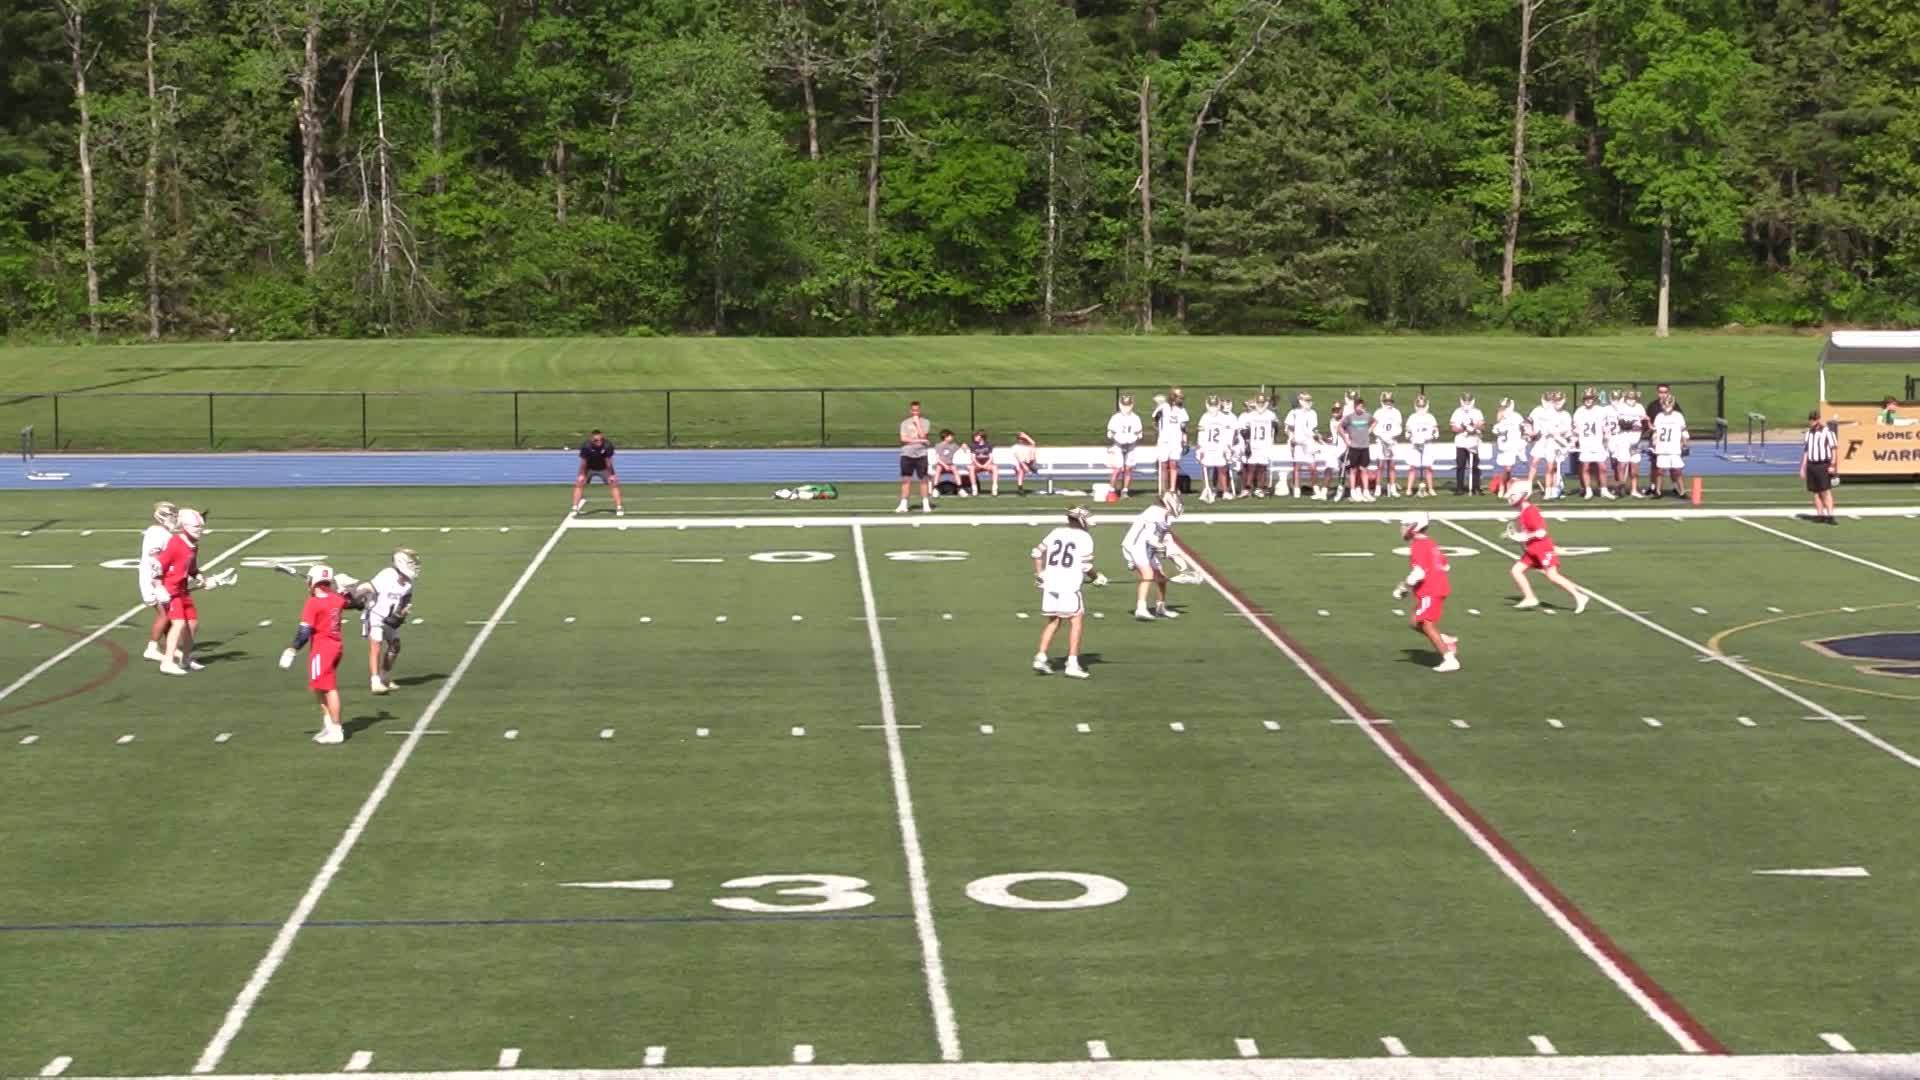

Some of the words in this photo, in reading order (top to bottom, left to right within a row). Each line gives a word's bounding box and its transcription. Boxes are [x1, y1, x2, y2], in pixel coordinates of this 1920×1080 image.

[1207, 427, 1220, 443] 12
[1253, 425, 1266, 440] 13
[1659, 427, 1672, 443] 21
[1877, 431, 1913, 440] HOME
[1844, 439, 1864, 460] F
[1048, 539, 1077, 568] 26
